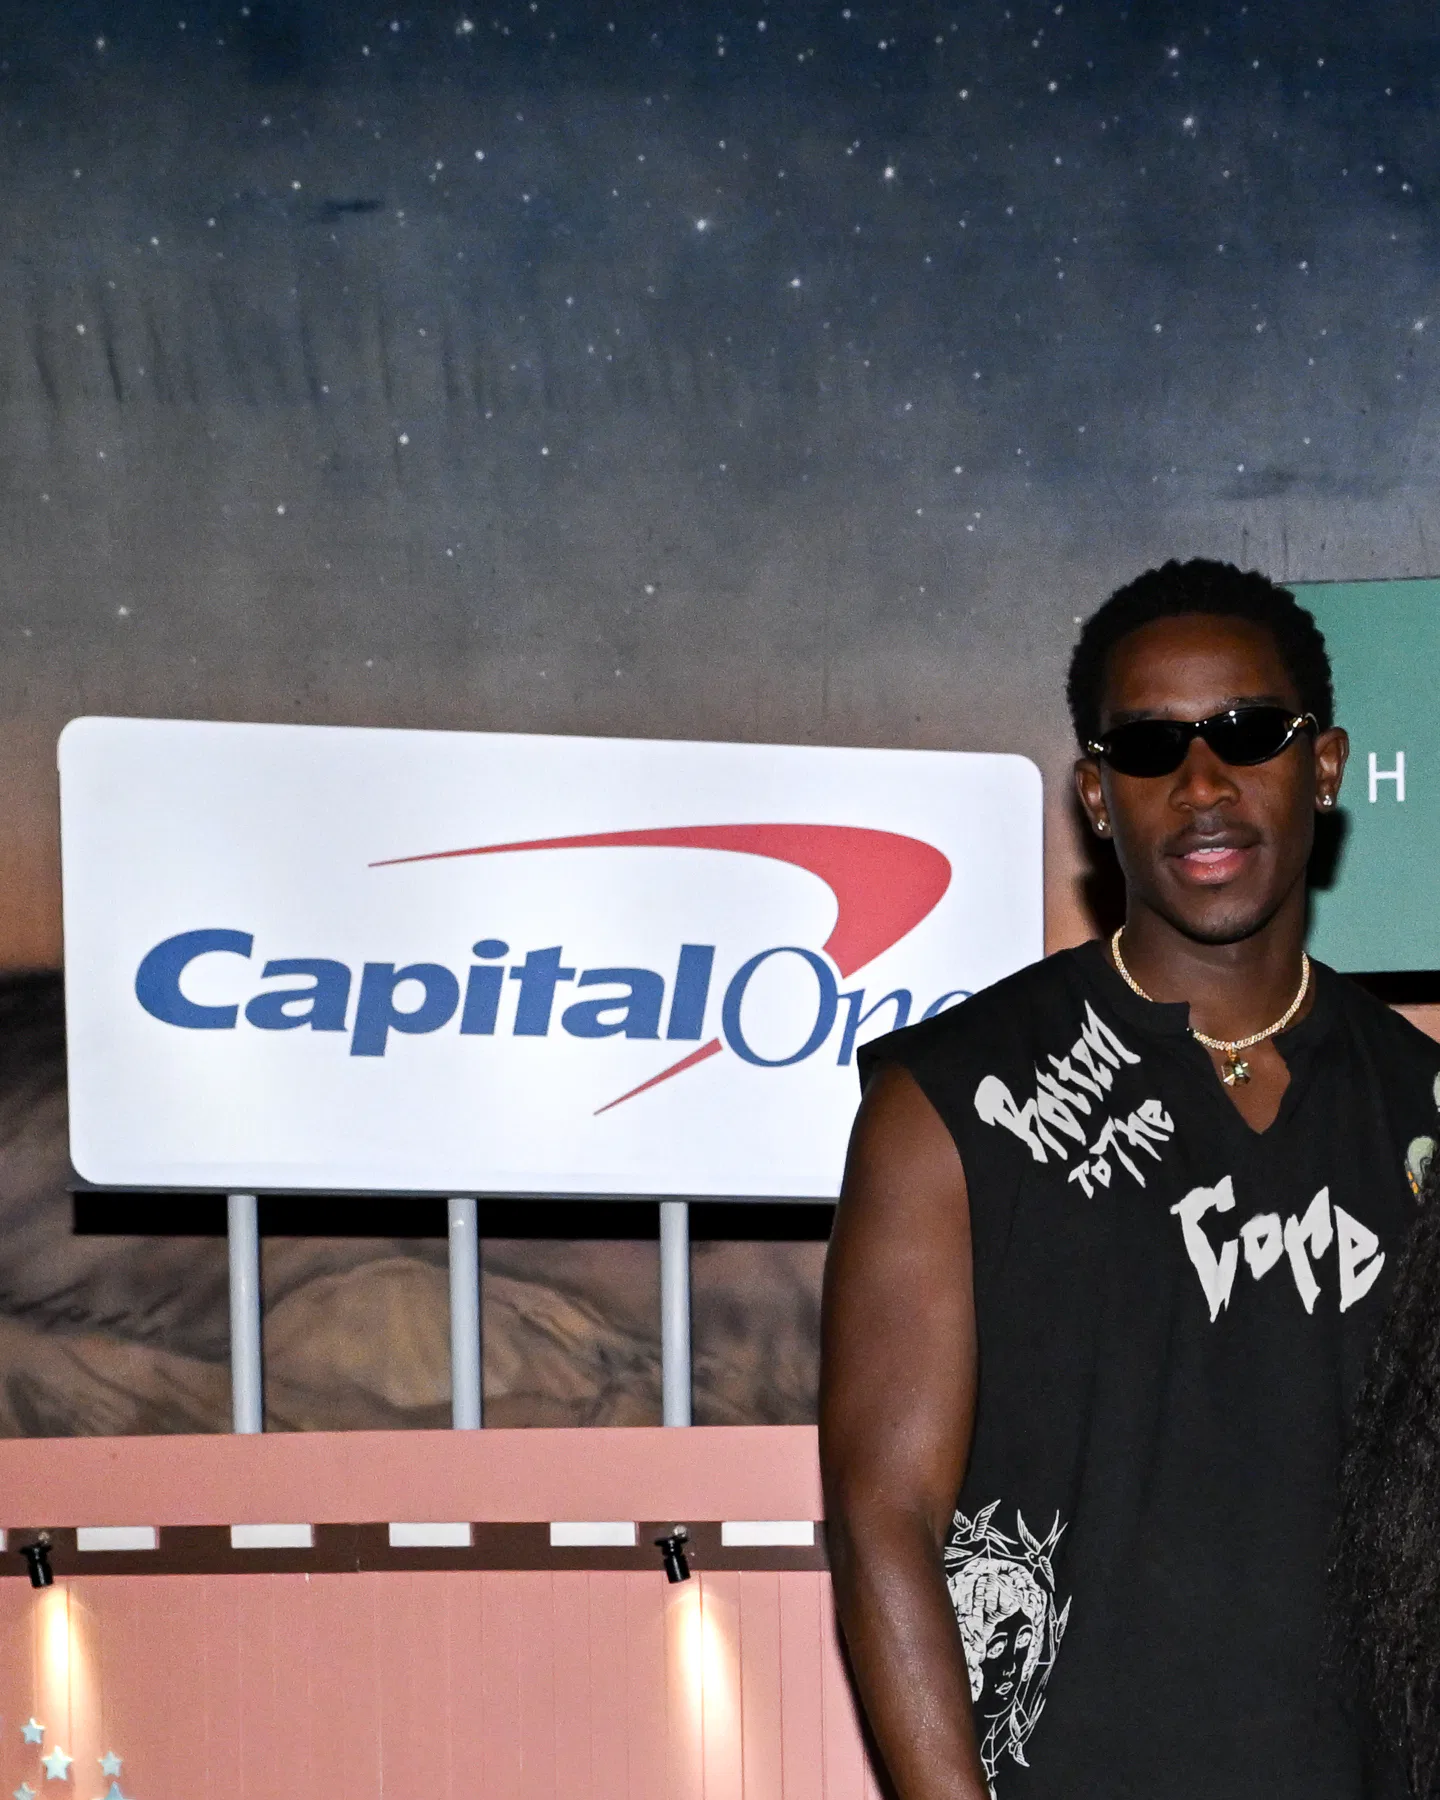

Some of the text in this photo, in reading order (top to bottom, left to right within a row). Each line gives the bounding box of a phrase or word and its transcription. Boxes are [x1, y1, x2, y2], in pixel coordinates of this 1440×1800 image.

[134, 928, 716, 1057] Capital
[974, 999, 1141, 1164] Rotten
[1171, 1174, 1386, 1323] Core
